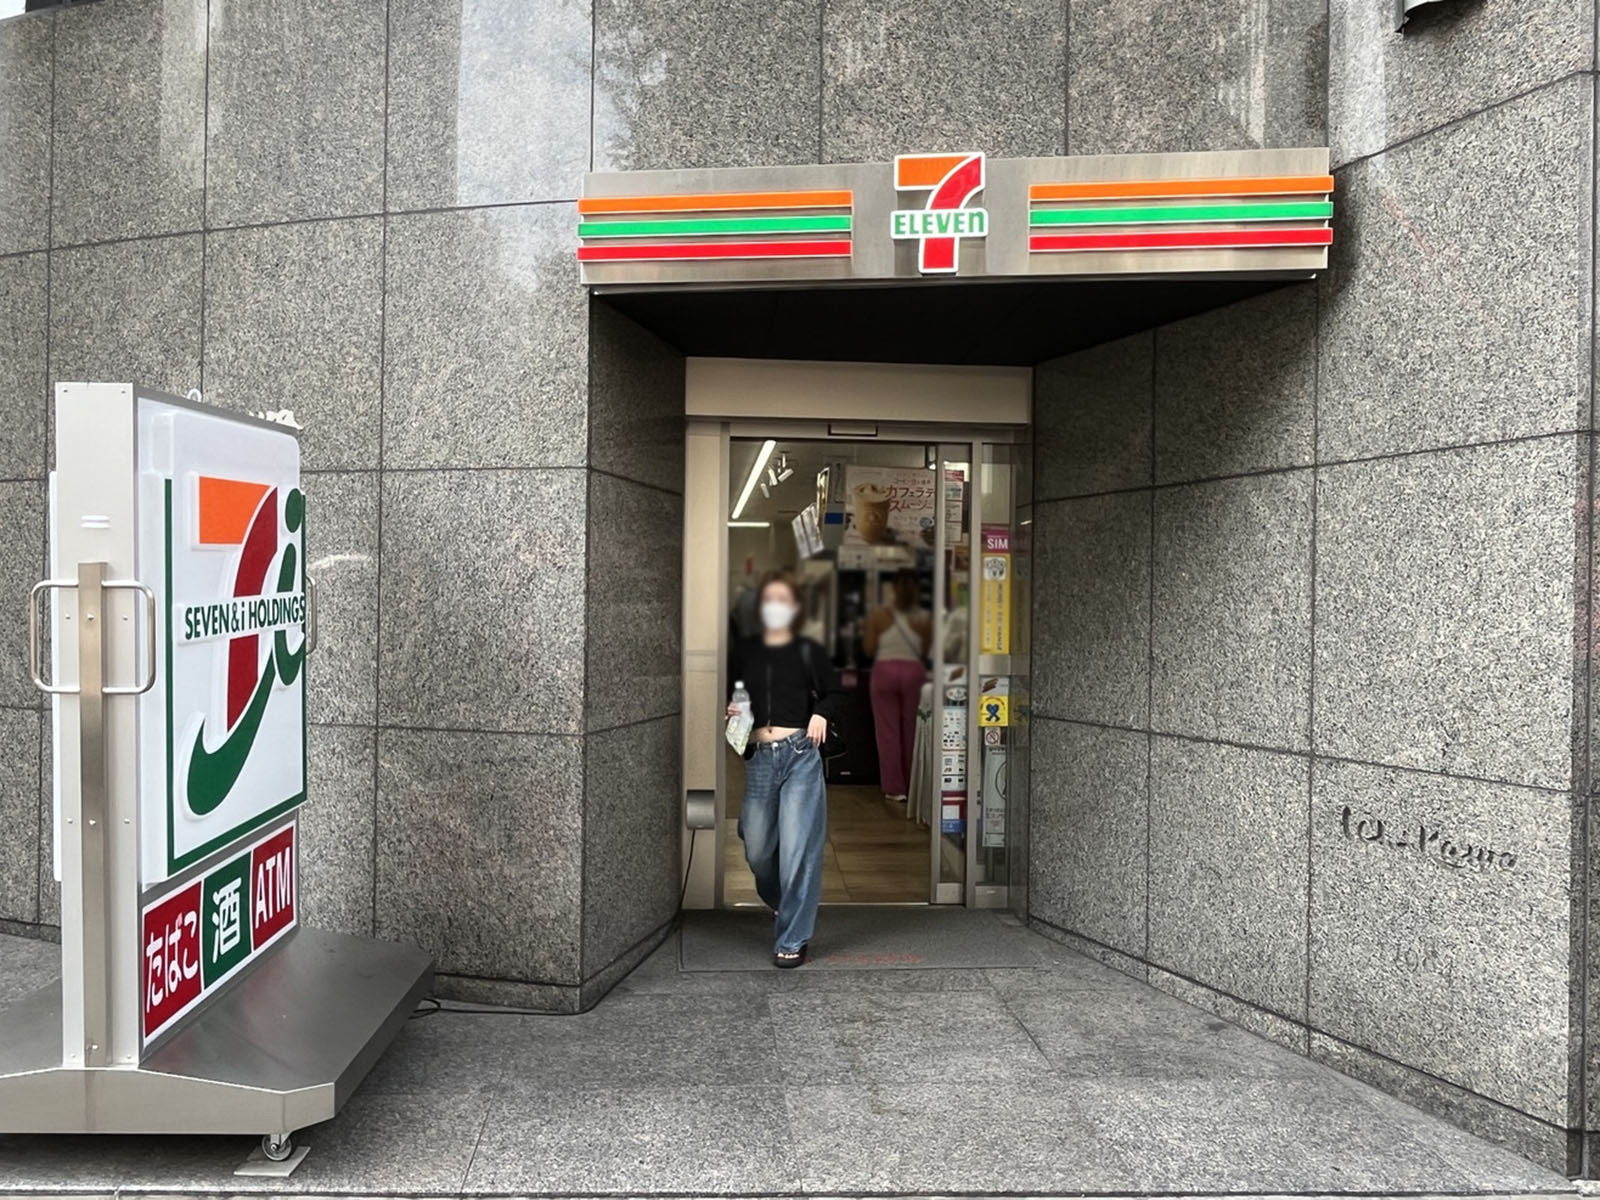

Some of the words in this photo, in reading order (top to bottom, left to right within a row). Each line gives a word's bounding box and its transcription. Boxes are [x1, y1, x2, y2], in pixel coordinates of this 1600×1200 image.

[895, 153, 984, 271] 7
[885, 484, 934, 498] カフェラテ
[888, 499, 934, 512] スムージー
[987, 538, 1009, 550] SIM
[248, 595, 305, 629] HOLDINGS
[255, 847, 291, 929] ATM
[212, 877, 242, 964] 酒
[146, 911, 198, 1013] たばこ
